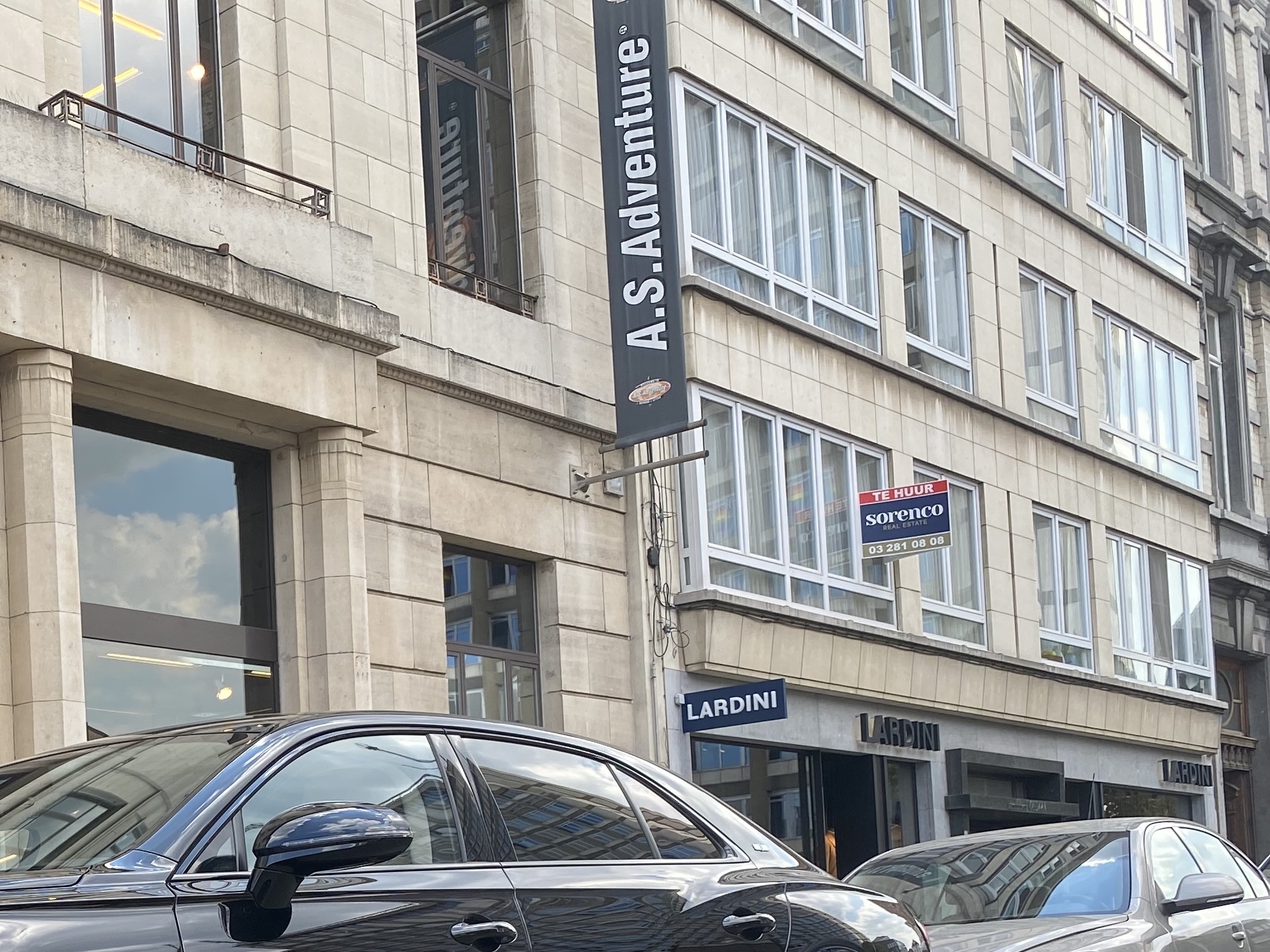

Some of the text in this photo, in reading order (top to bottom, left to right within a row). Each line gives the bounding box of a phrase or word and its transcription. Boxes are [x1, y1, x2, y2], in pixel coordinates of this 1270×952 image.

[872, 484, 934, 501] TE HUUR
[866, 504, 944, 526] sorenco
[883, 519, 928, 530] REAL ESTATE
[869, 536, 944, 554] 03 281 08 08
[687, 690, 777, 721] LARDINI
[860, 712, 940, 751] LARDINI
[1162, 758, 1213, 787] LARDINI
